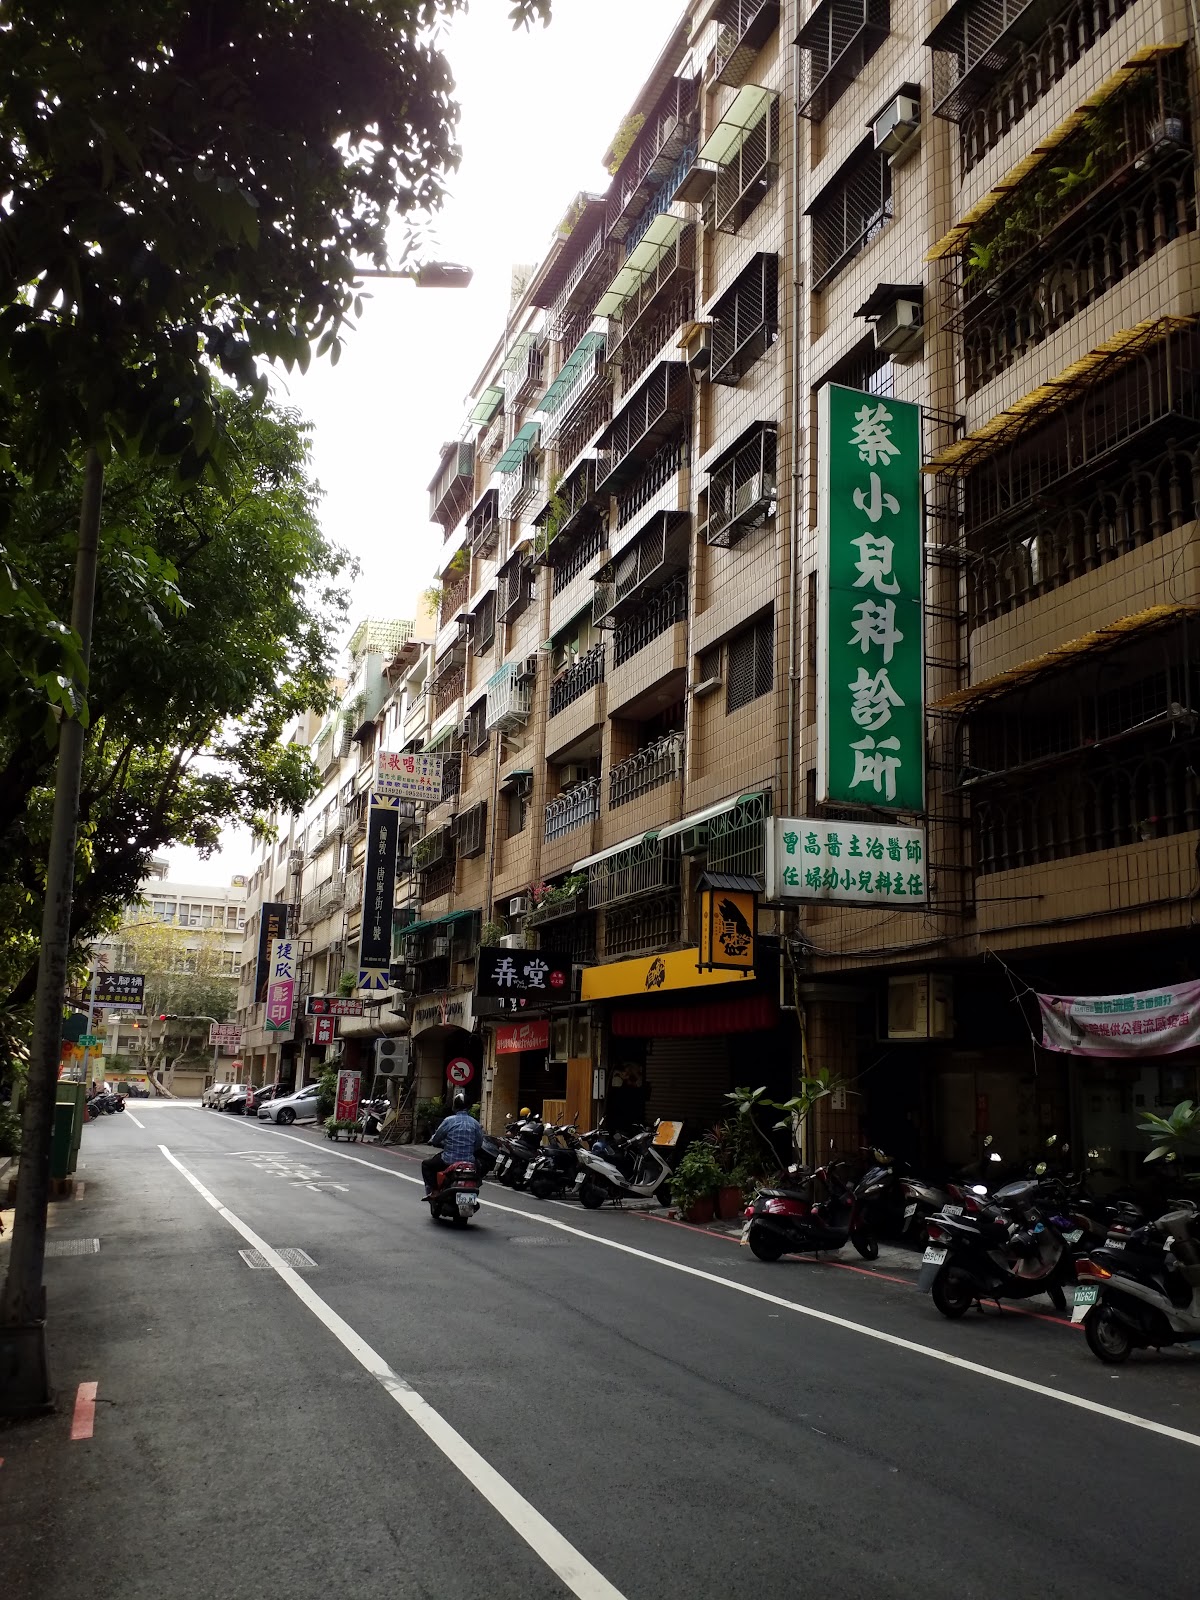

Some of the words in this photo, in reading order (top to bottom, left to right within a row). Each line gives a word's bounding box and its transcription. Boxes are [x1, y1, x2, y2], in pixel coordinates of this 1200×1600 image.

[847, 402, 904, 802] 蔡小兒科診所
[388, 754, 415, 773] 歌唱
[804, 866, 924, 896] 婦幼小兒科主任
[275, 942, 294, 979] 捷欣
[271, 986, 289, 1021] 影印
[319, 1019, 331, 1041] 牛排
